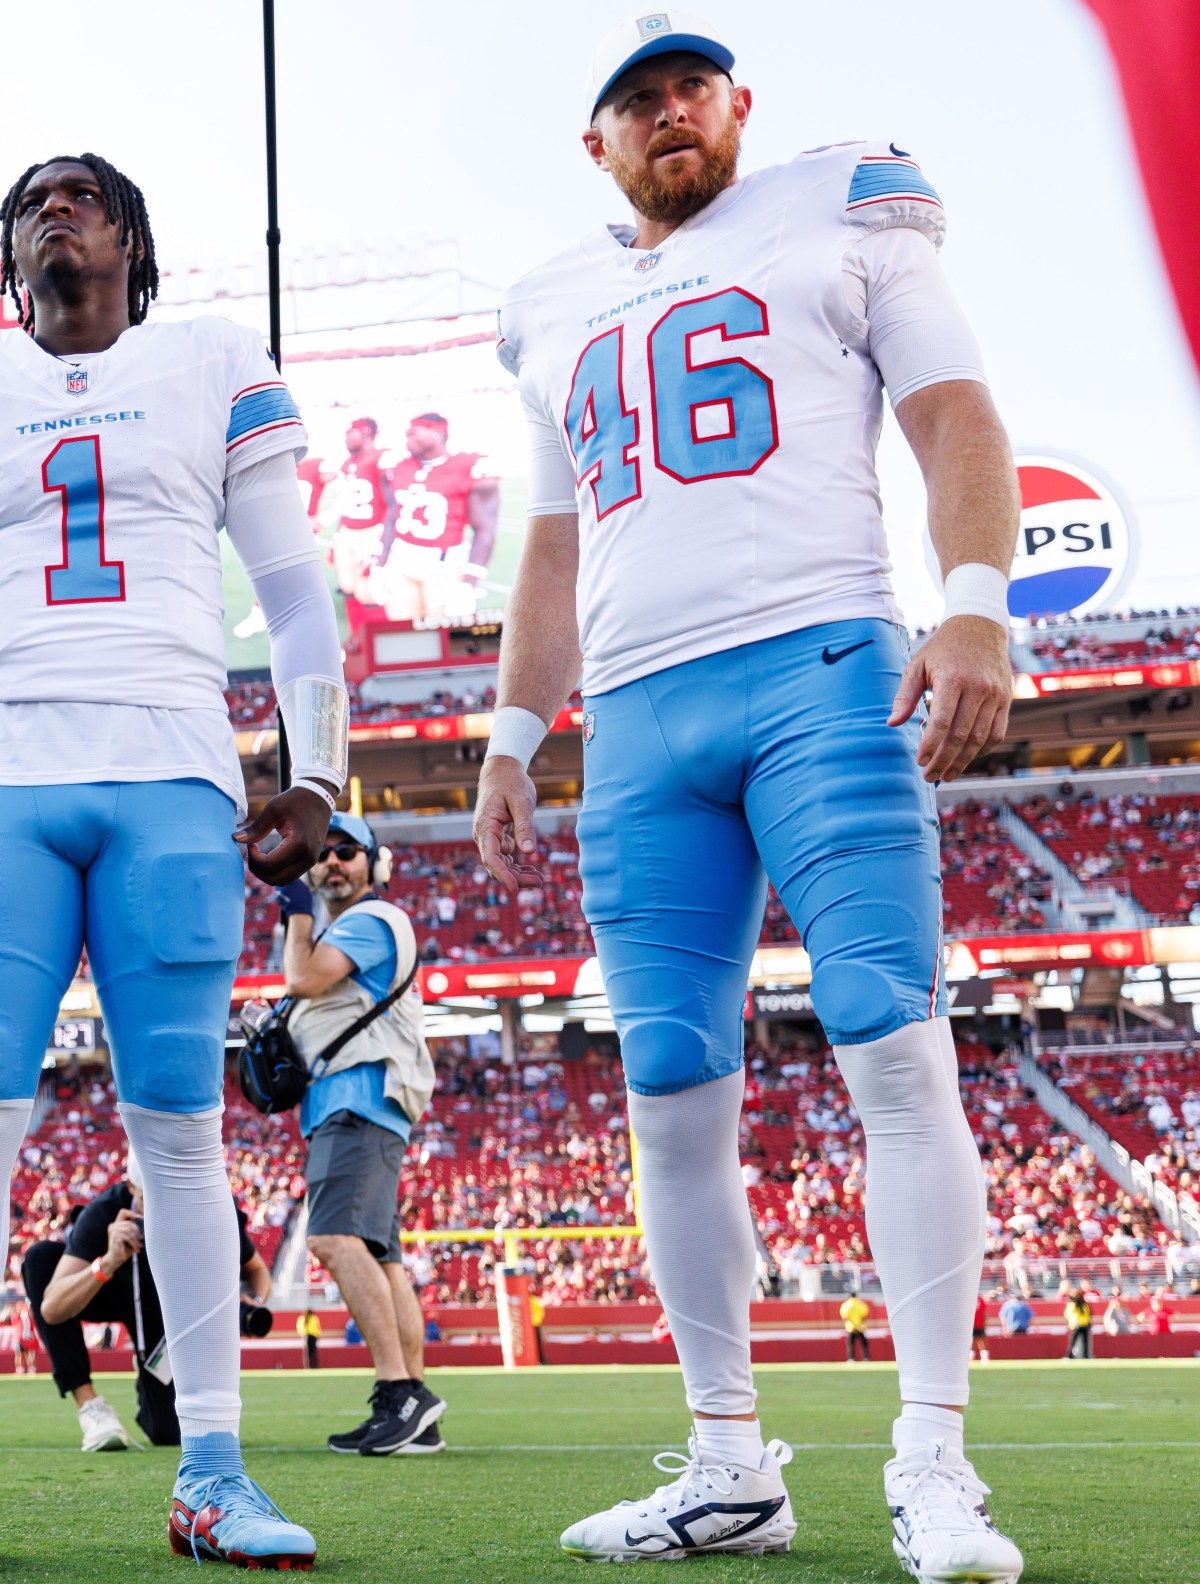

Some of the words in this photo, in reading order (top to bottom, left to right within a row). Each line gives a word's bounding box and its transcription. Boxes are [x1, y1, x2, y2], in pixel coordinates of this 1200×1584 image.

[585, 275, 710, 328] TENNESSEE
[564, 286, 779, 522] 46
[16, 411, 146, 435] TENNESSEE
[41, 434, 126, 606] 1
[1016, 521, 1112, 557] PSI
[755, 993, 813, 1012] TOYOT
[704, 1519, 745, 1543] ALPHA
